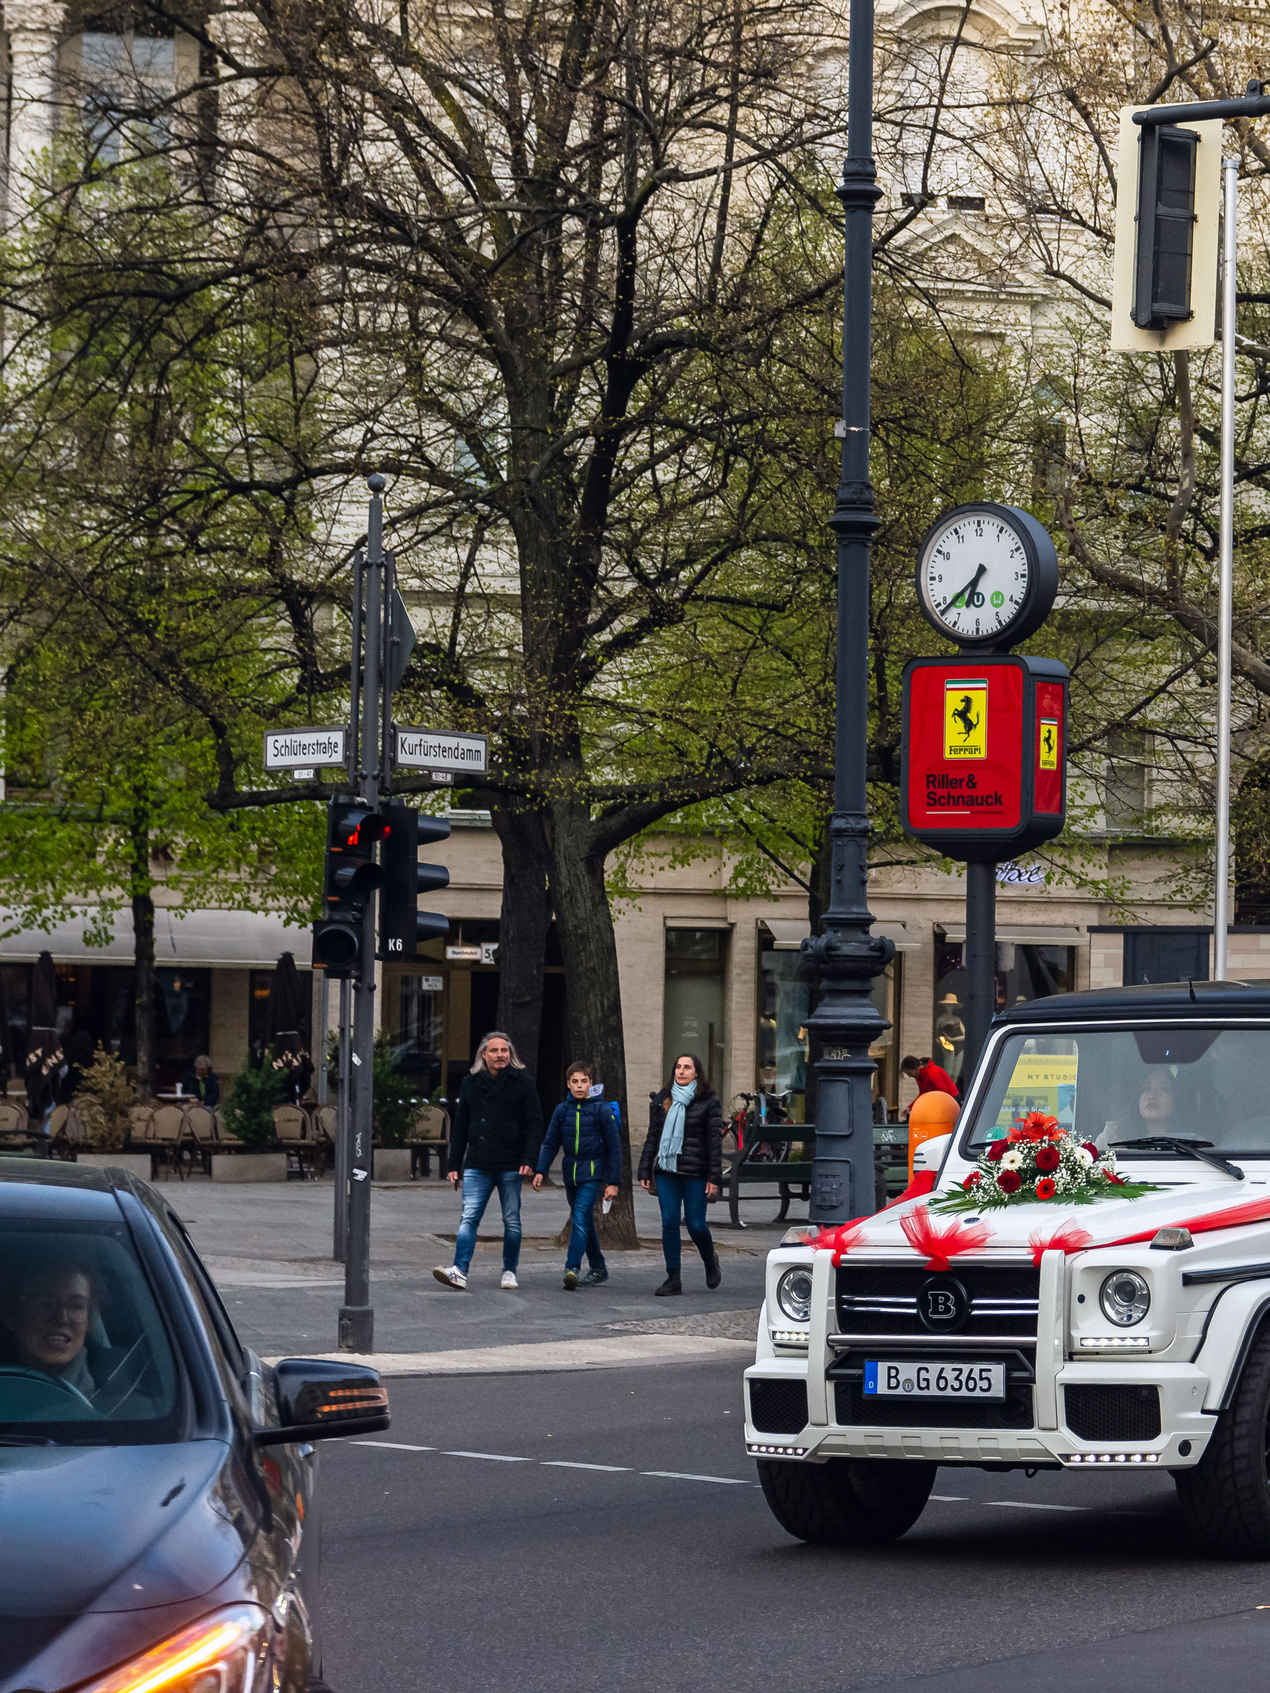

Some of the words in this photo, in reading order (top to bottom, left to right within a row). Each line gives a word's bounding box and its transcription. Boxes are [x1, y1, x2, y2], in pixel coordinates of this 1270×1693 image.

[975, 528, 983, 537] 12
[957, 535, 964, 544] 11
[996, 534, 1000, 542] 1
[943, 552, 950, 561] 10
[1010, 550, 1014, 558] 2
[938, 574, 942, 583] 9
[1014, 572, 1018, 580] 3
[942, 596, 947, 604] 8
[1009, 594, 1014, 603] 4
[956, 612, 960, 621] 7
[995, 612, 1000, 620] 5
[976, 618, 980, 626] 6
[272, 737, 339, 758] Schlüterstraße
[400, 736, 482, 762] Kurfürstendamm
[948, 746, 981, 756] Ferrari
[926, 791, 1003, 807] Schnauck
[388, 939, 402, 951] K6
